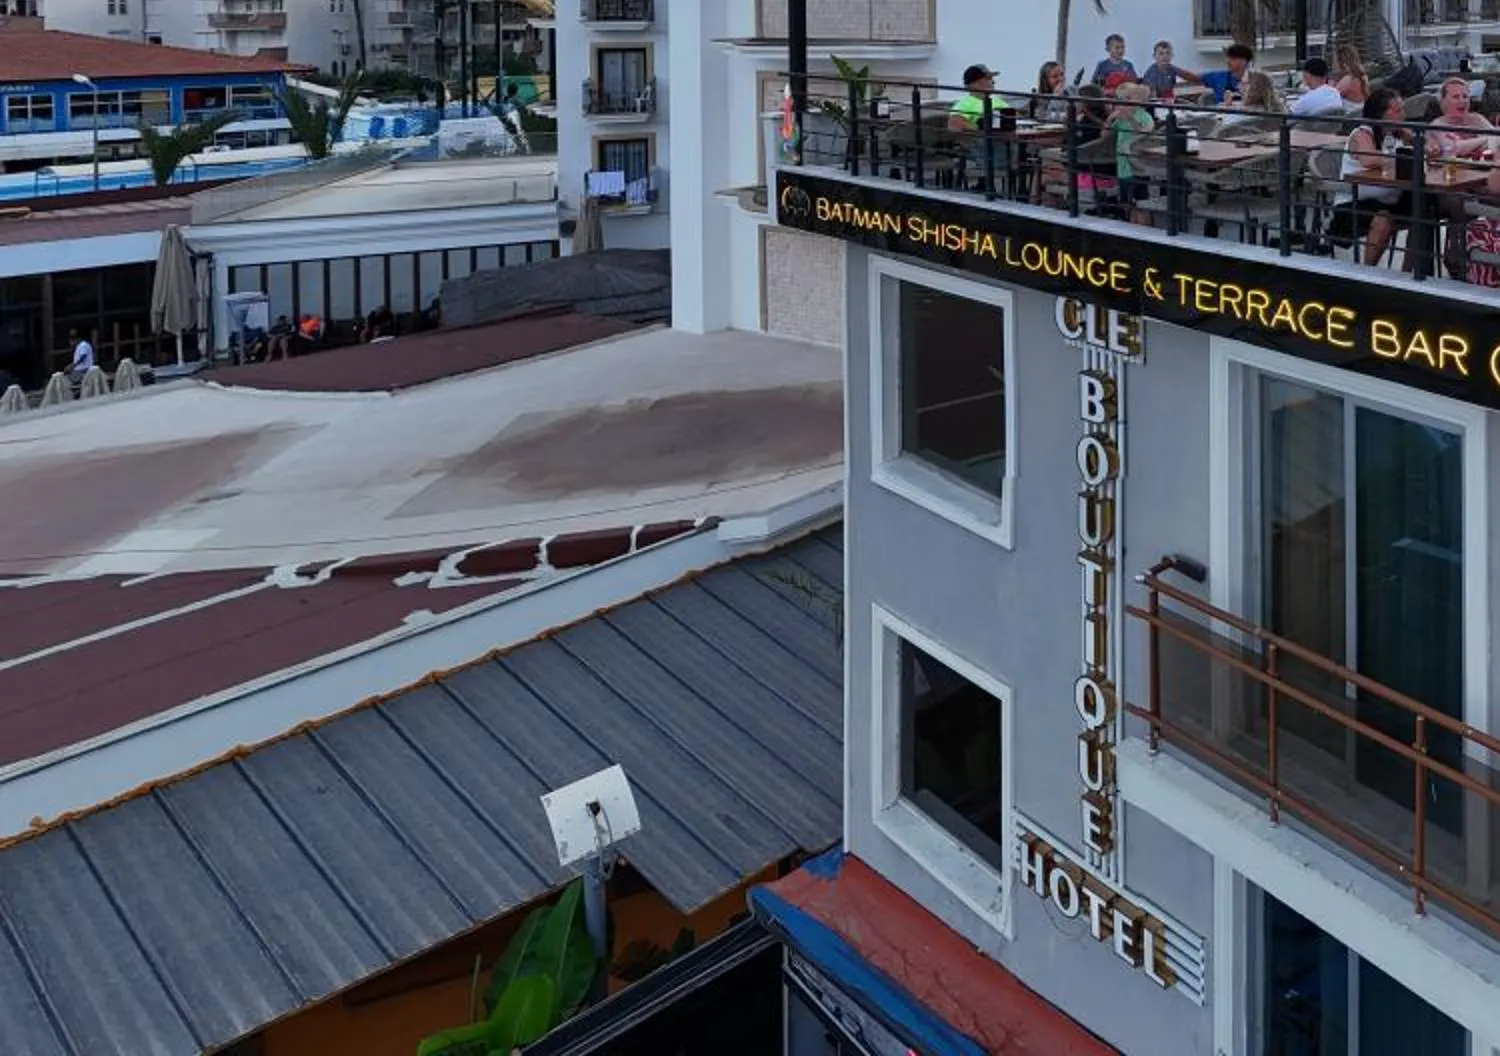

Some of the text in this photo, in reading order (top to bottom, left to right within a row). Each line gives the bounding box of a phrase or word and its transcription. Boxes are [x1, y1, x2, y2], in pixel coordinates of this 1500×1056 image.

[815, 197, 1469, 376] BATMAN SHISHA LOUNGE & TERRACE BAR
[1076, 371, 1111, 853] BOUTIQUE
[1020, 840, 1167, 987] HOTEL
